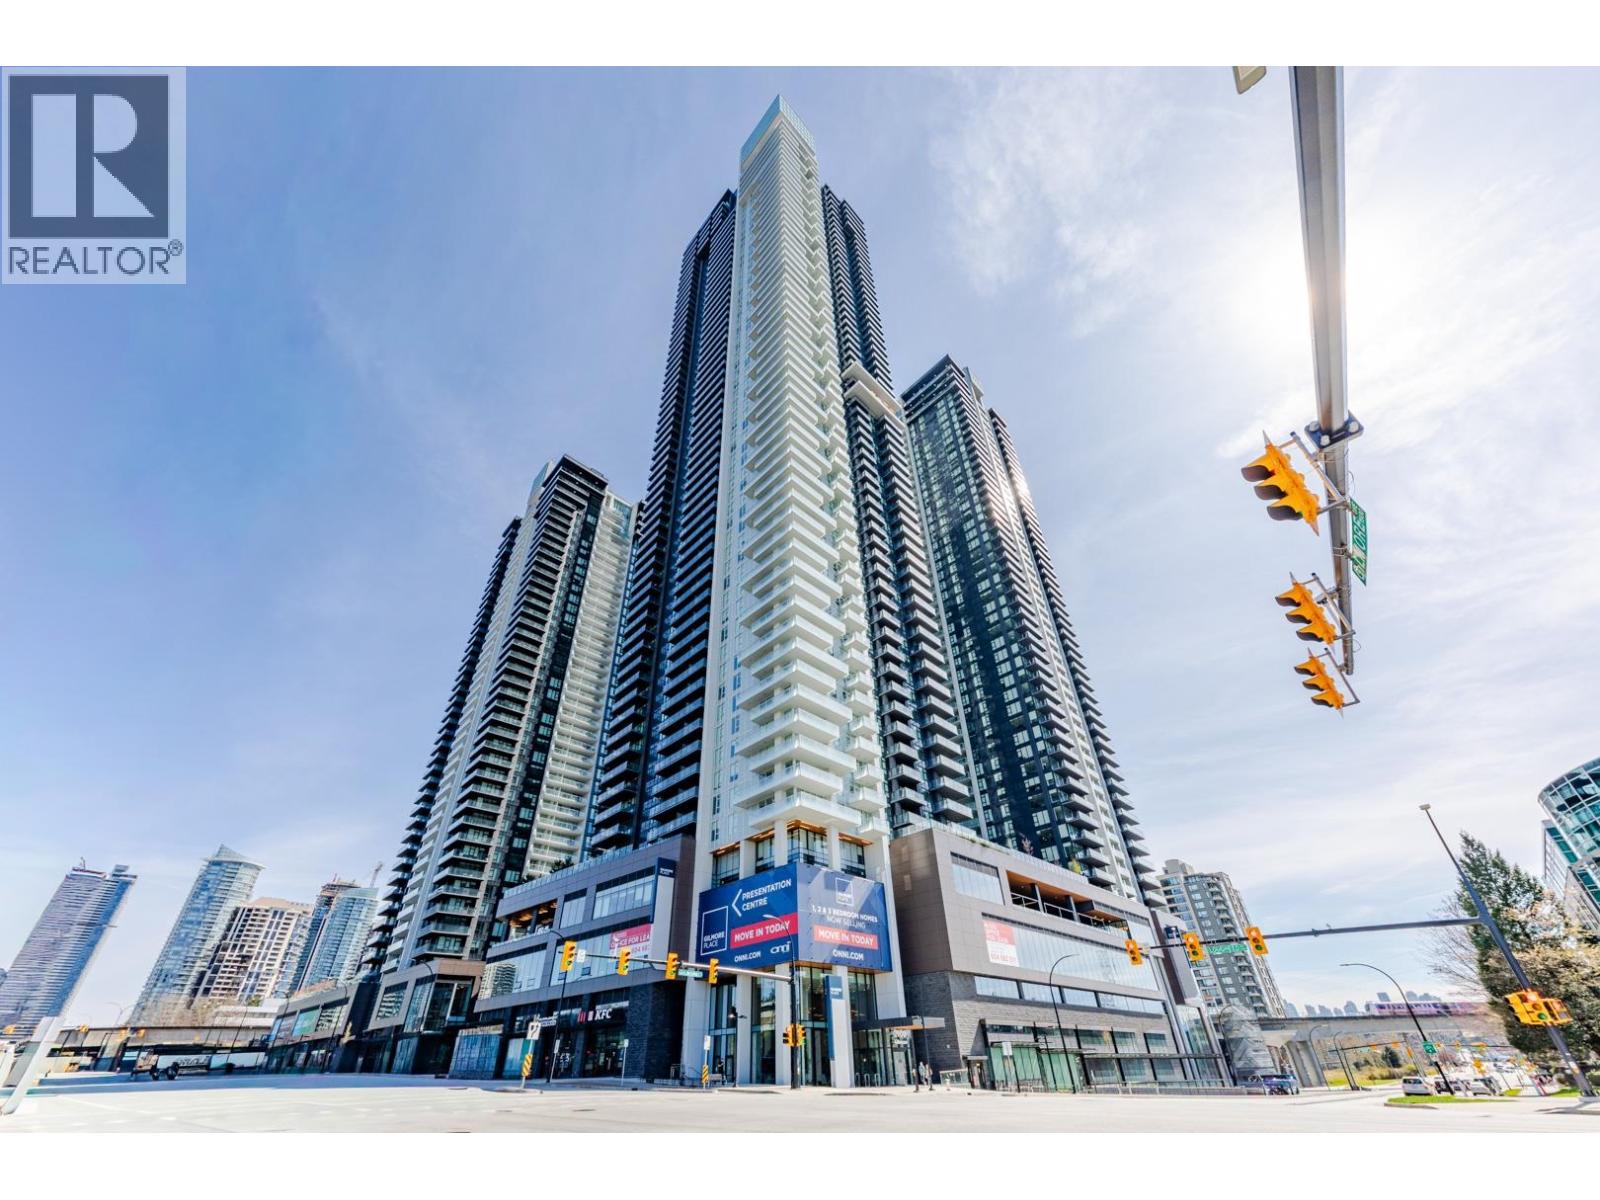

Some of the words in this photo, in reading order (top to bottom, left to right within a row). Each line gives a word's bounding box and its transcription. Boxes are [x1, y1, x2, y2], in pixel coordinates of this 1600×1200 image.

[1352, 515, 1366, 582] GILORE
[742, 878, 791, 901] PRESENTATION
[741, 897, 768, 911] CENTRE
[833, 908, 859, 918] BEDROOM
[859, 913, 878, 923] HOMES
[704, 931, 725, 942] GILMORE
[734, 930, 754, 942] MOVE
[756, 927, 764, 937] IN
[766, 920, 790, 935] TODAY
[817, 929, 840, 940] MOVE
[841, 932, 850, 942] IN
[851, 935, 874, 945] TODAY
[628, 936, 639, 944] FOR
[703, 940, 718, 949] PLACE
[734, 951, 762, 962] ONNI.COM
[832, 949, 864, 961] ONNI.COM
[594, 1007, 613, 1020] KFC
